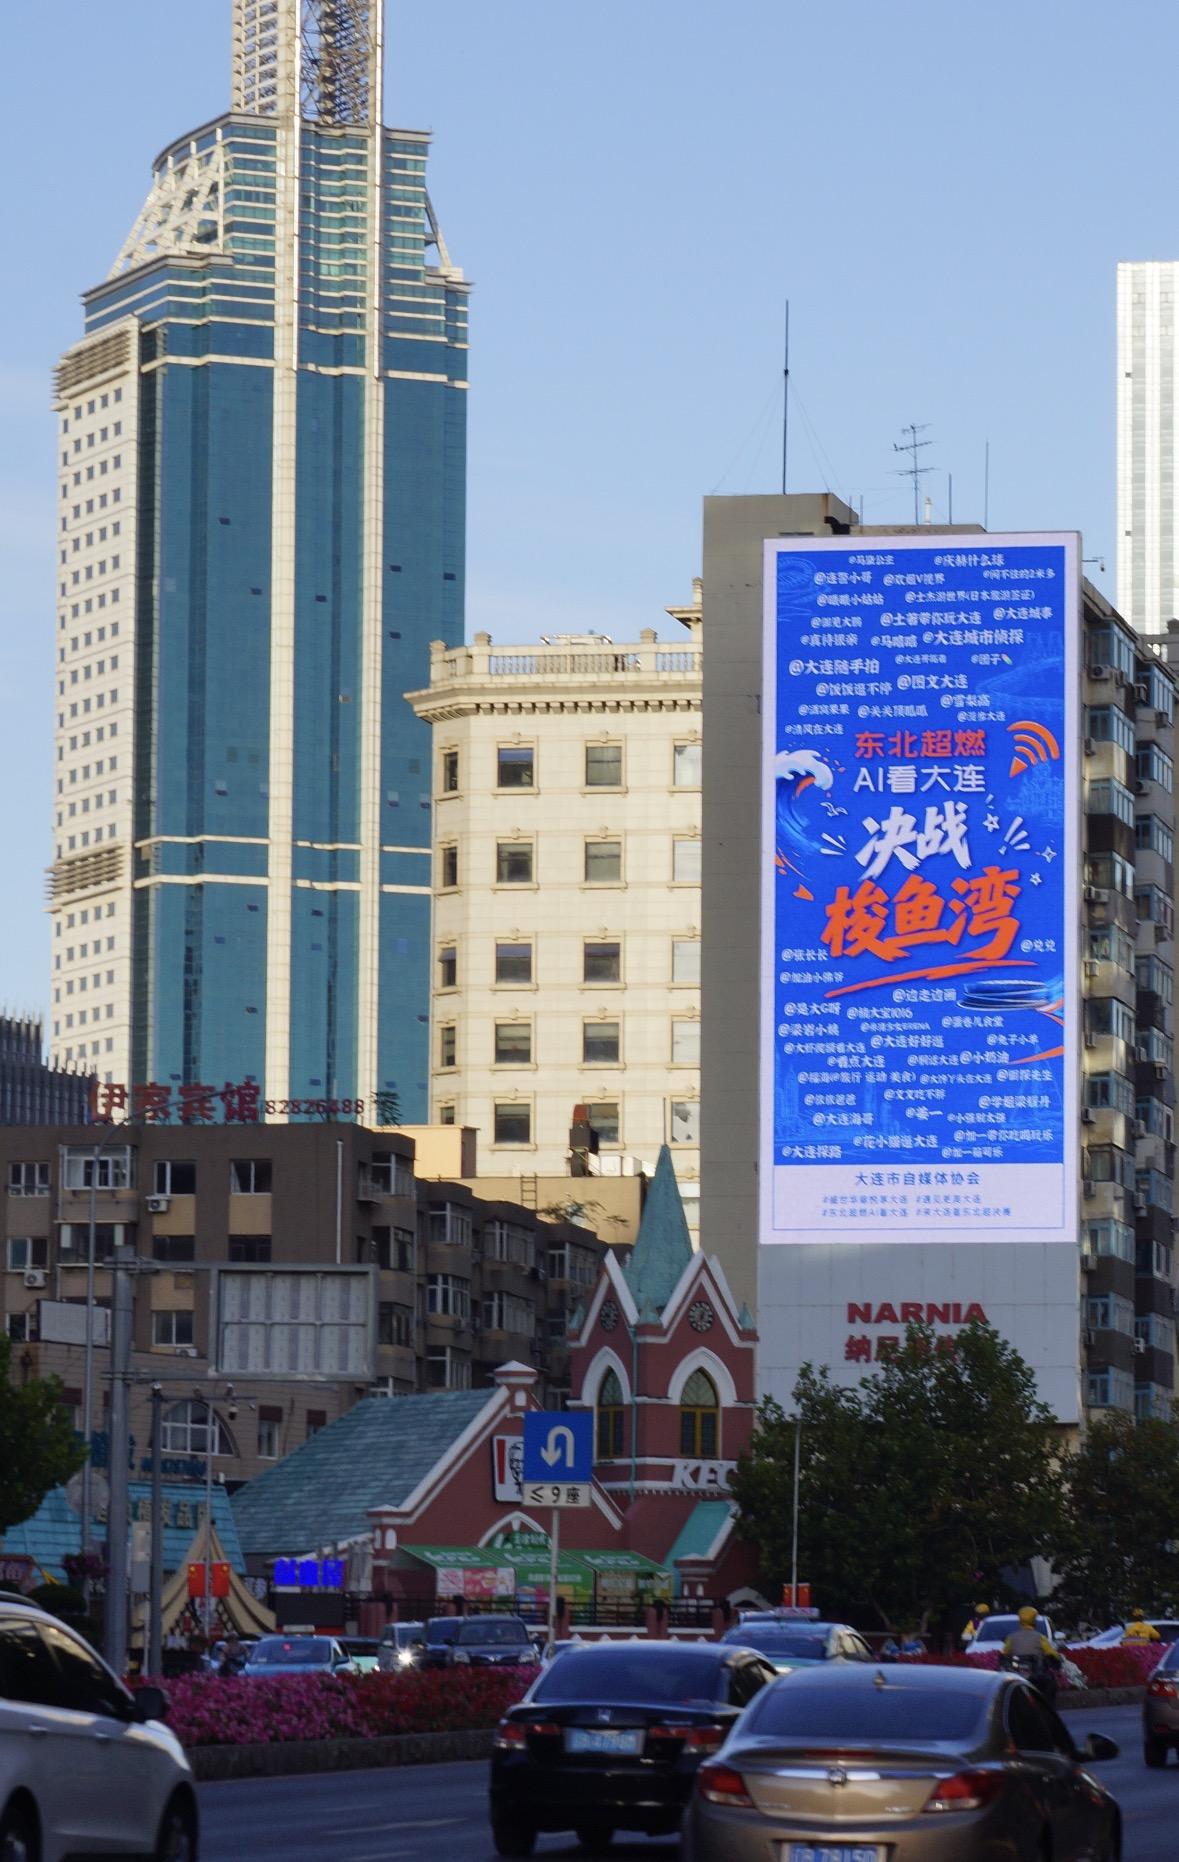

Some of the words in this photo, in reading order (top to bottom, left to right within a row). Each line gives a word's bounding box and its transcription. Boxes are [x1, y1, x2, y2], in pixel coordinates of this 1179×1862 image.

[855, 730, 986, 759] 东北超燃
[852, 765, 986, 794] AI看大连
[855, 801, 973, 880] 决战
[821, 866, 1021, 961] 梭鱼湾
[856, 1172, 980, 1186] 大连市自媒体协会
[848, 1303, 987, 1324] NARNIA
[672, 1461, 737, 1491] KFC
